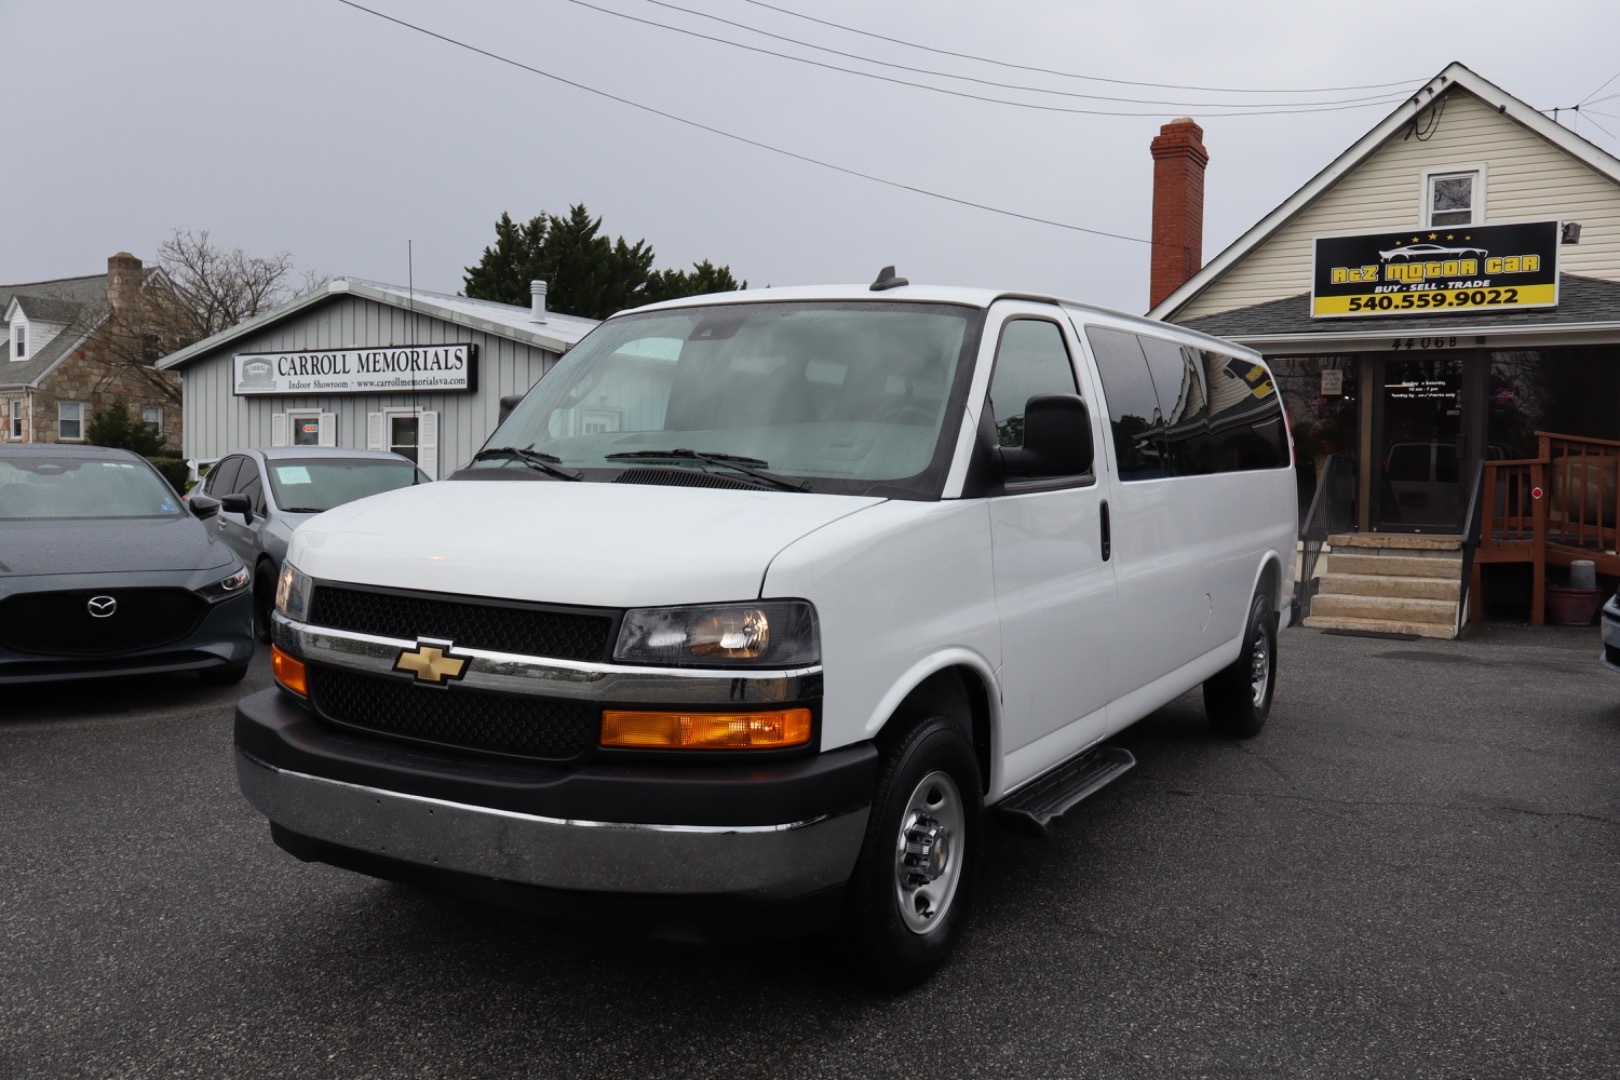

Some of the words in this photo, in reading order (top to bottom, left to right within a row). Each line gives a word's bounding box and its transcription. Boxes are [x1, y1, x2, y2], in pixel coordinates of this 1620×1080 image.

[1374, 283, 1401, 294] BUY
[1409, 282, 1438, 292] SELL
[1447, 279, 1491, 289] TRADE
[1349, 289, 1518, 311] 540.559.9022
[278, 353, 351, 376] CARROLL
[356, 349, 463, 373] MEMORIALS
[288, 380, 311, 390] Indoor
[313, 379, 349, 390] Showroom
[356, 376, 466, 389] www.carrollmemorialsva.com
